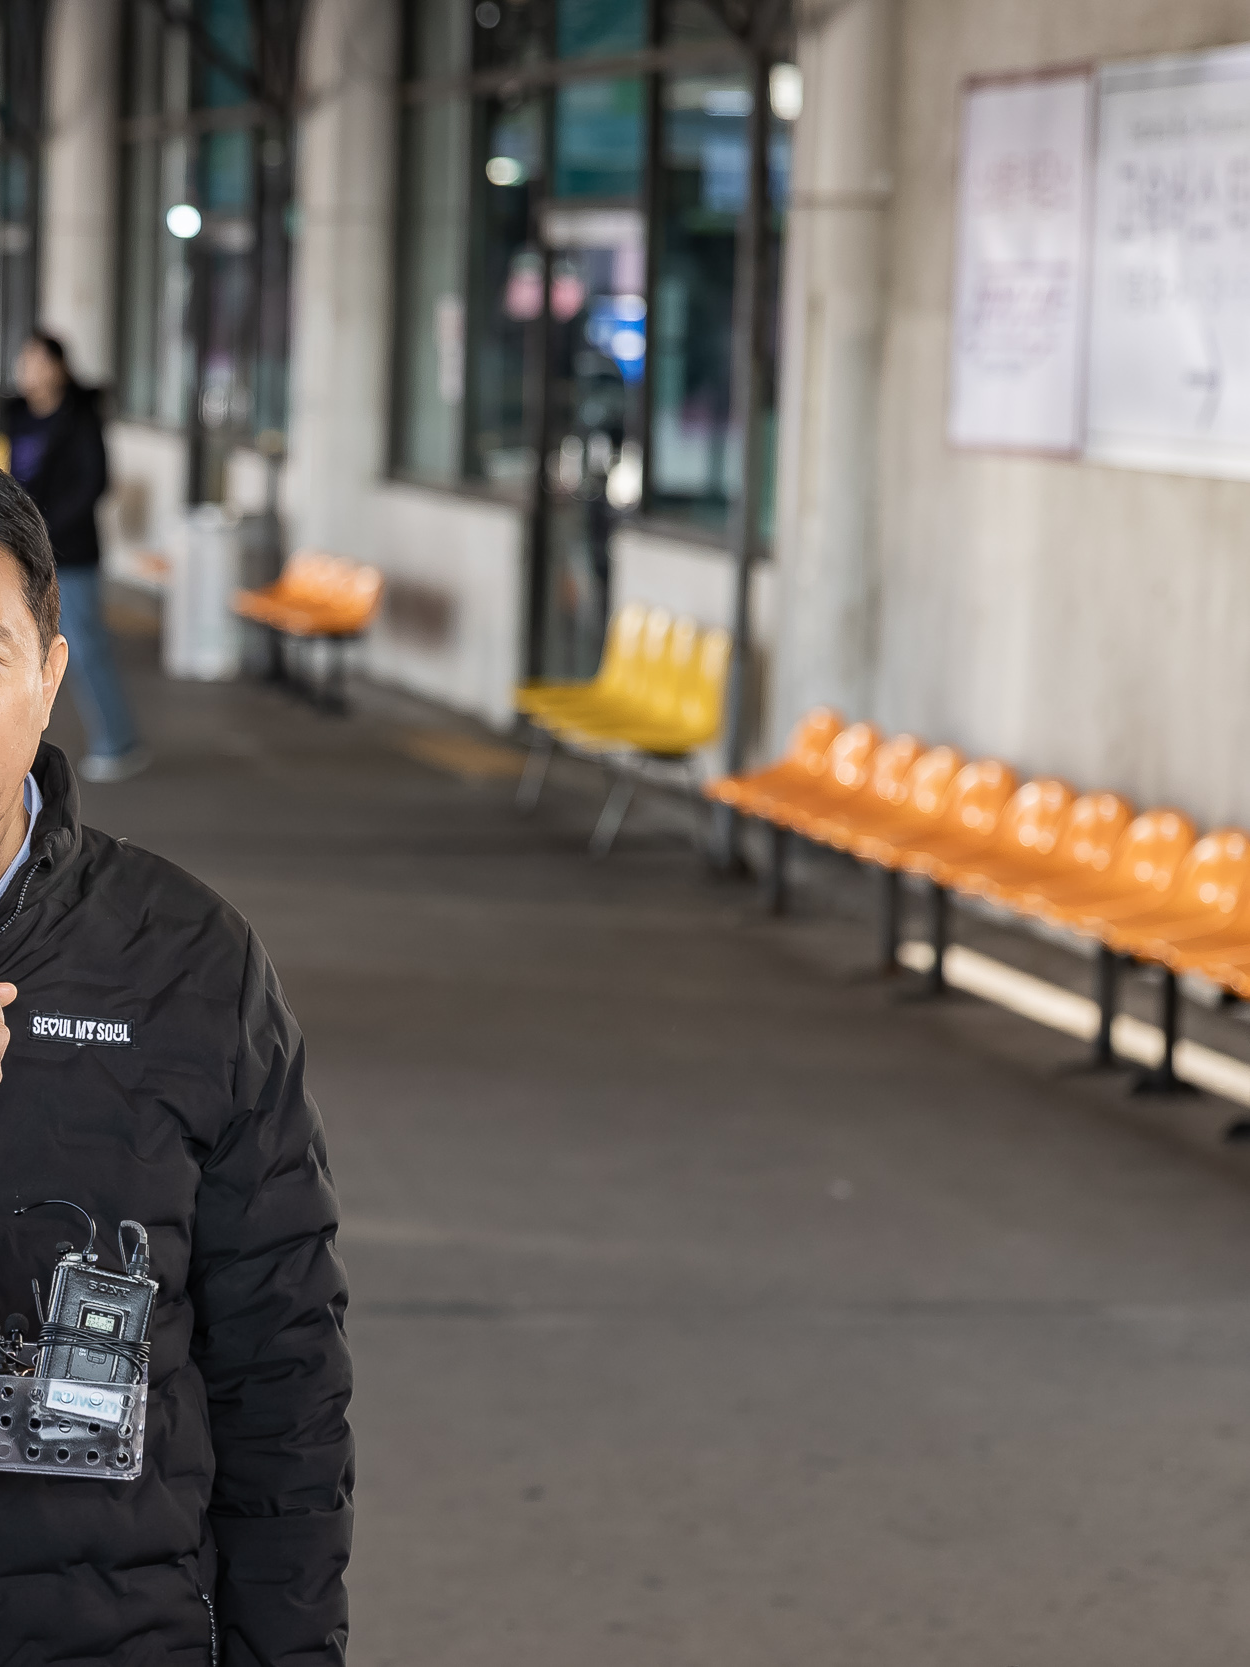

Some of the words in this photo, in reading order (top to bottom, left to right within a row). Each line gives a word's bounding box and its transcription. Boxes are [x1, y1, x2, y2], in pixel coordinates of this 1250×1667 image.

[32, 1016, 73, 1038] SEOUL
[97, 1023, 130, 1042] SOUL
[88, 1280, 130, 1297] SONY
